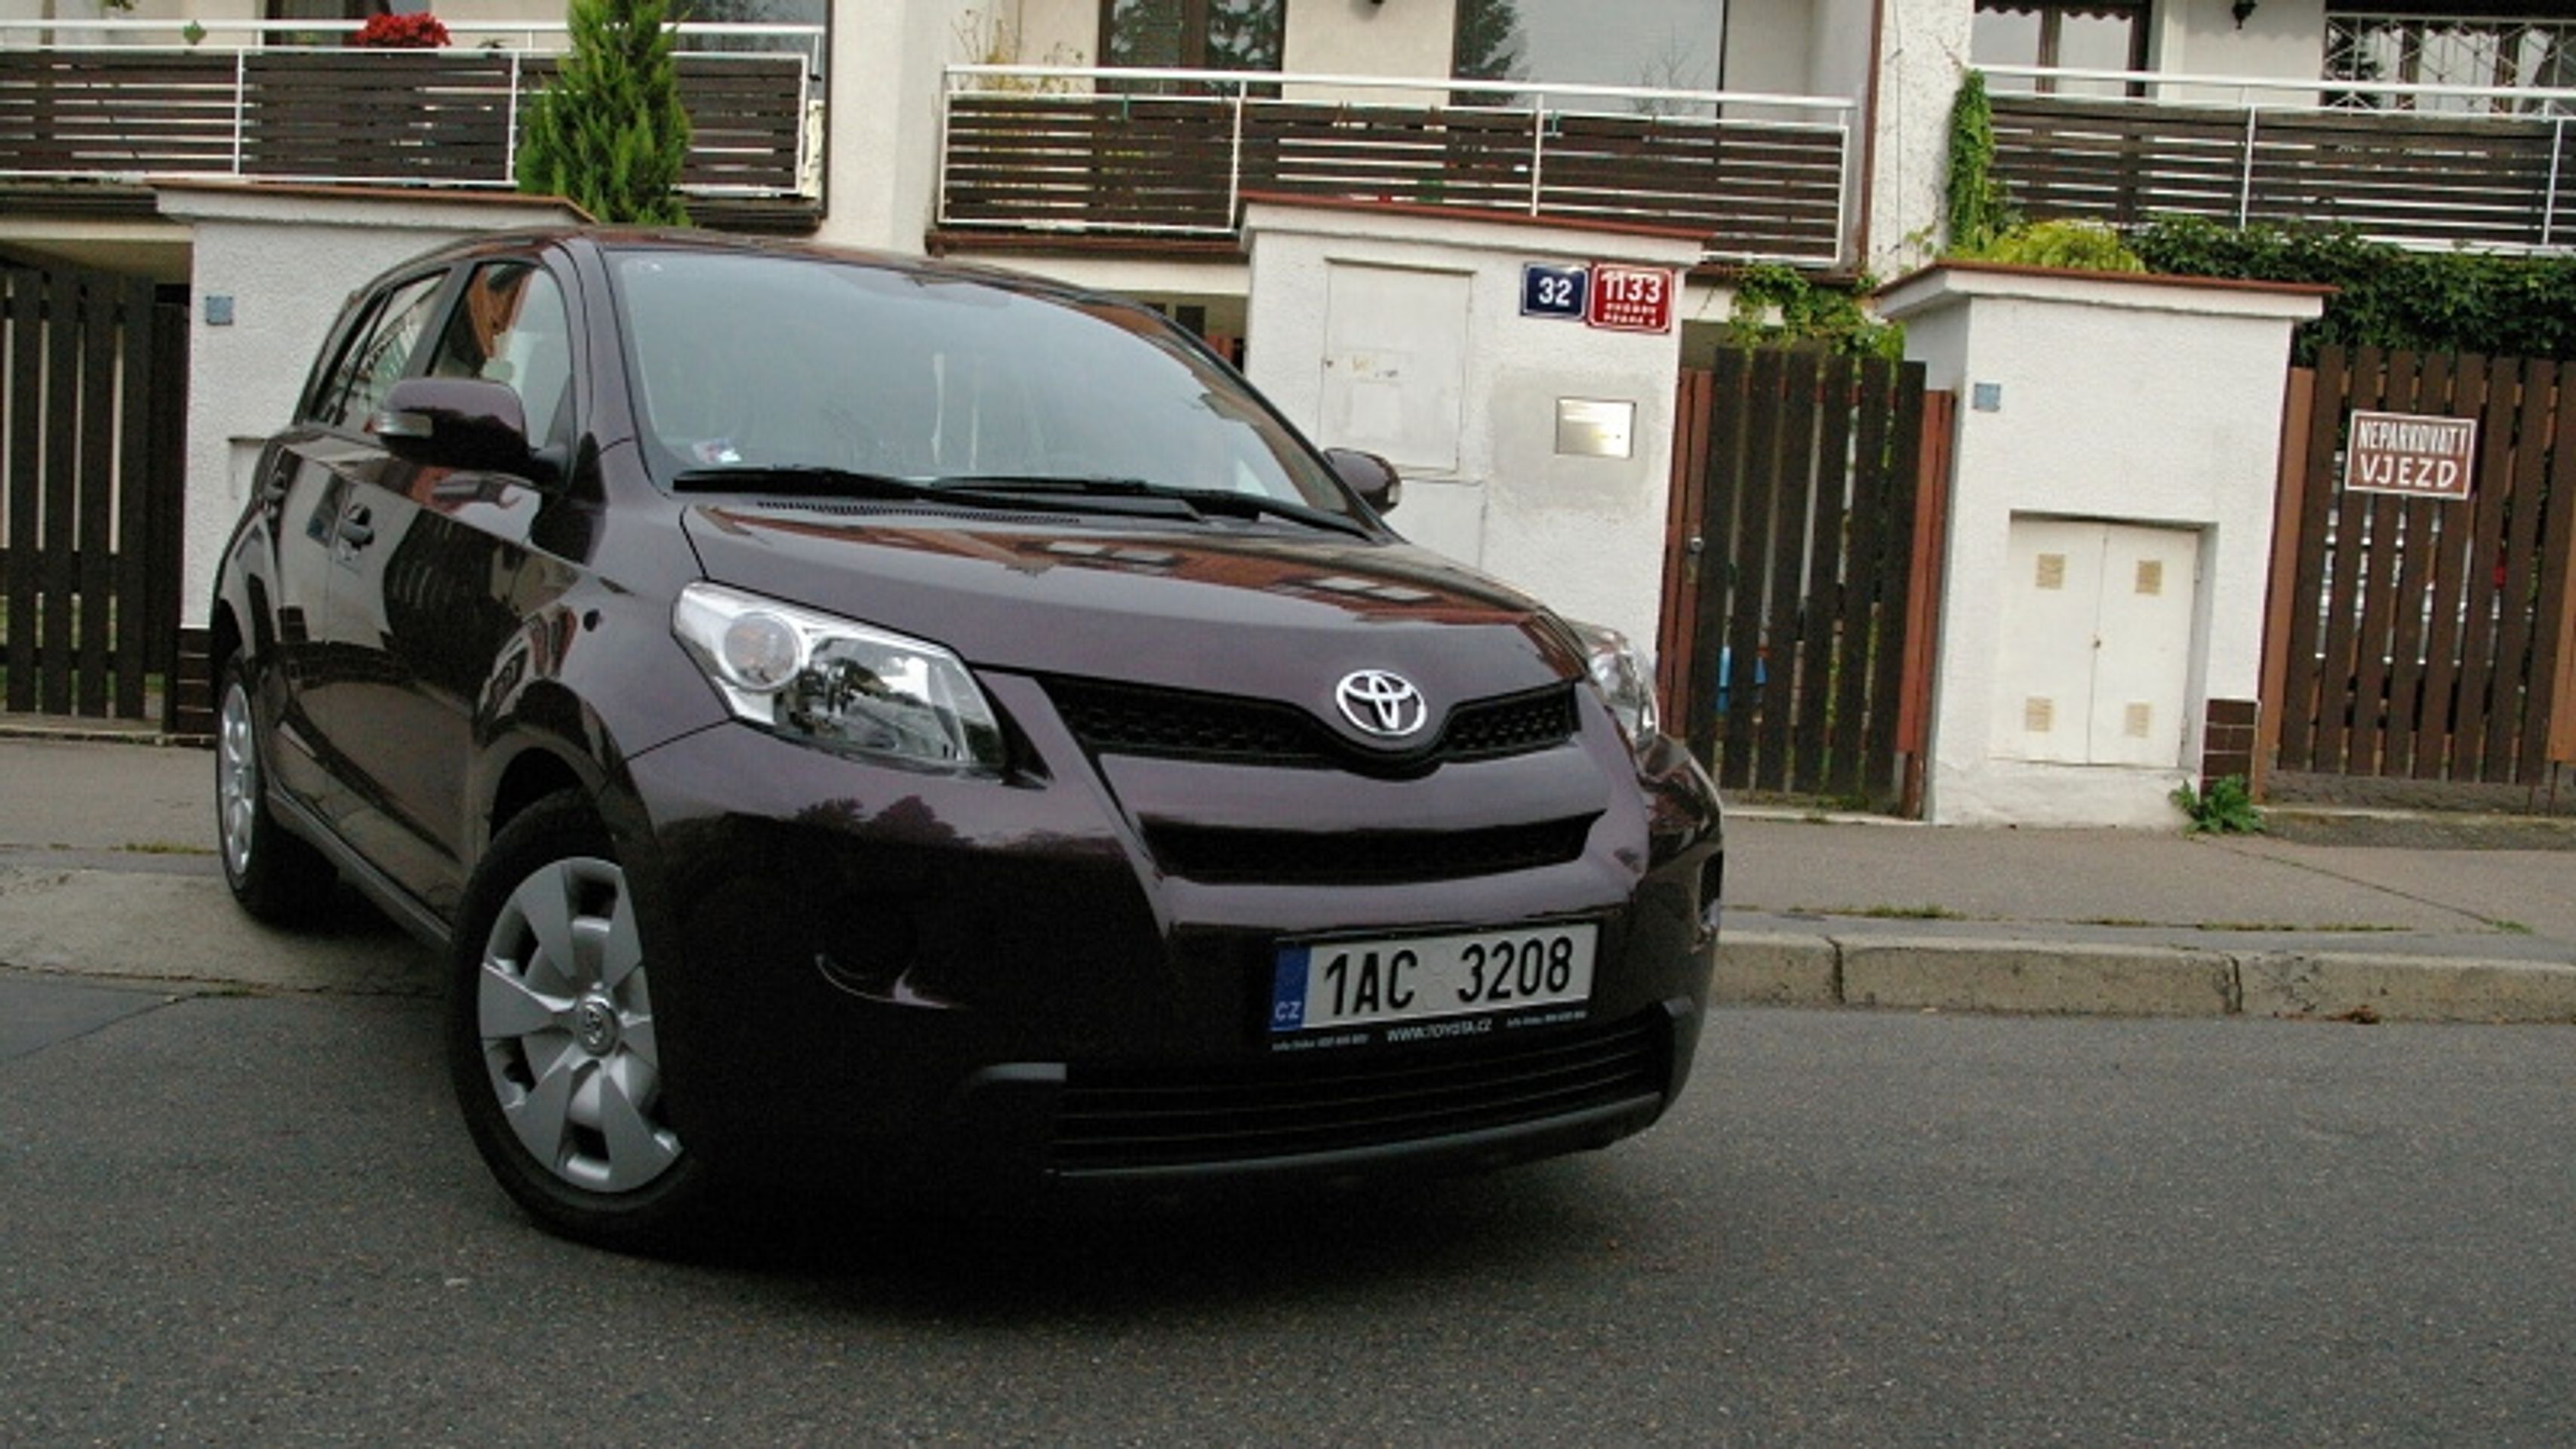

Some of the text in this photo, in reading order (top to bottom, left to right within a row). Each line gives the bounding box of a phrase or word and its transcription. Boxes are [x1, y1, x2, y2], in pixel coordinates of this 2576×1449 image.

[1539, 276, 1572, 306] 32
[1600, 270, 1661, 303] 1133
[2359, 454, 2458, 487] VJEZD
[1325, 937, 1573, 1016] 1AC 3208
[1275, 1001, 1302, 1020] CZ
